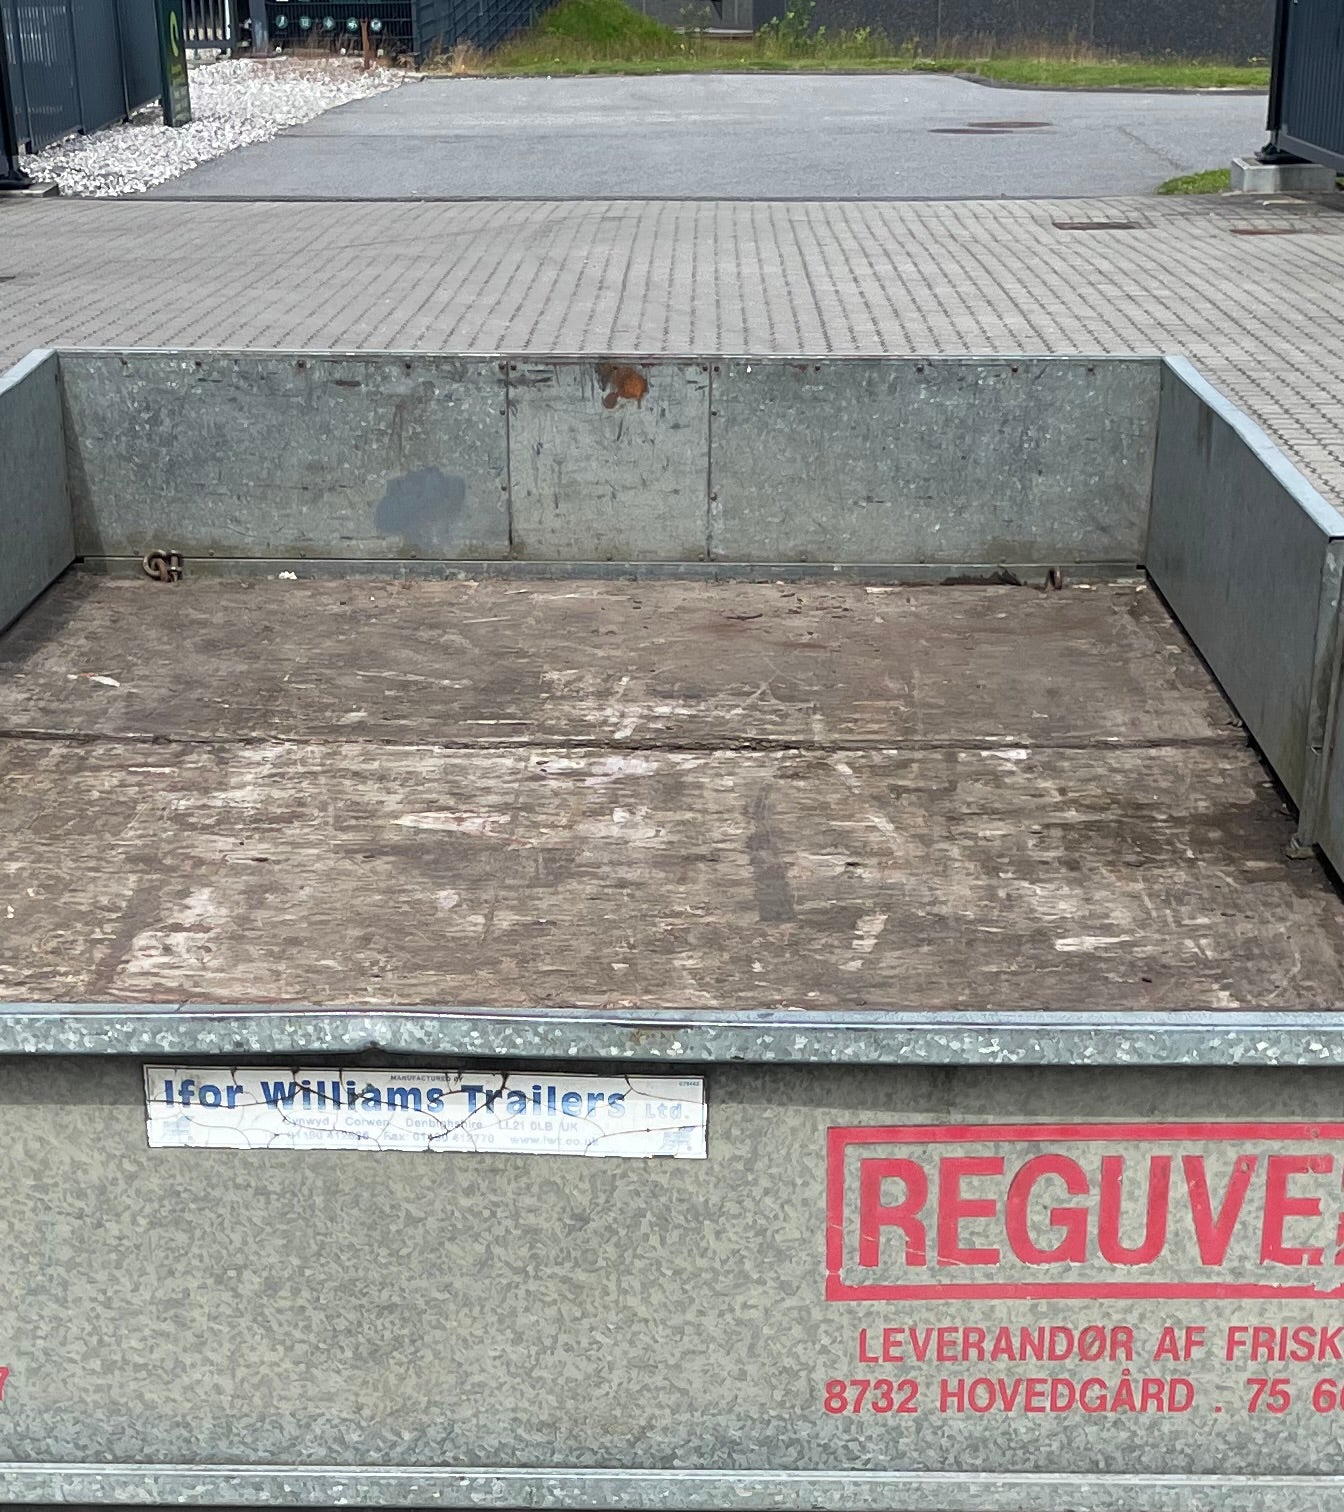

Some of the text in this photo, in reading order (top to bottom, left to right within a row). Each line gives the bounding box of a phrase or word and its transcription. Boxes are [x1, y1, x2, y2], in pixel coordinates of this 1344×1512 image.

[390, 1074, 451, 1083] MANUFACTURED
[164, 1079, 244, 1110] Ifor
[260, 1079, 446, 1113] Williams
[461, 1084, 626, 1119] Trailers
[345, 1116, 390, 1127] Corwen
[562, 1121, 579, 1133] UK
[858, 1325, 1134, 1363] LEVERANDØR
[1153, 1325, 1207, 1362] AF
[1225, 1325, 1344, 1363] FRISK
[824, 1379, 920, 1414] 8732
[939, 1369, 1195, 1414] HOVEDGÅRD
[1247, 1378, 1292, 1414] 75
